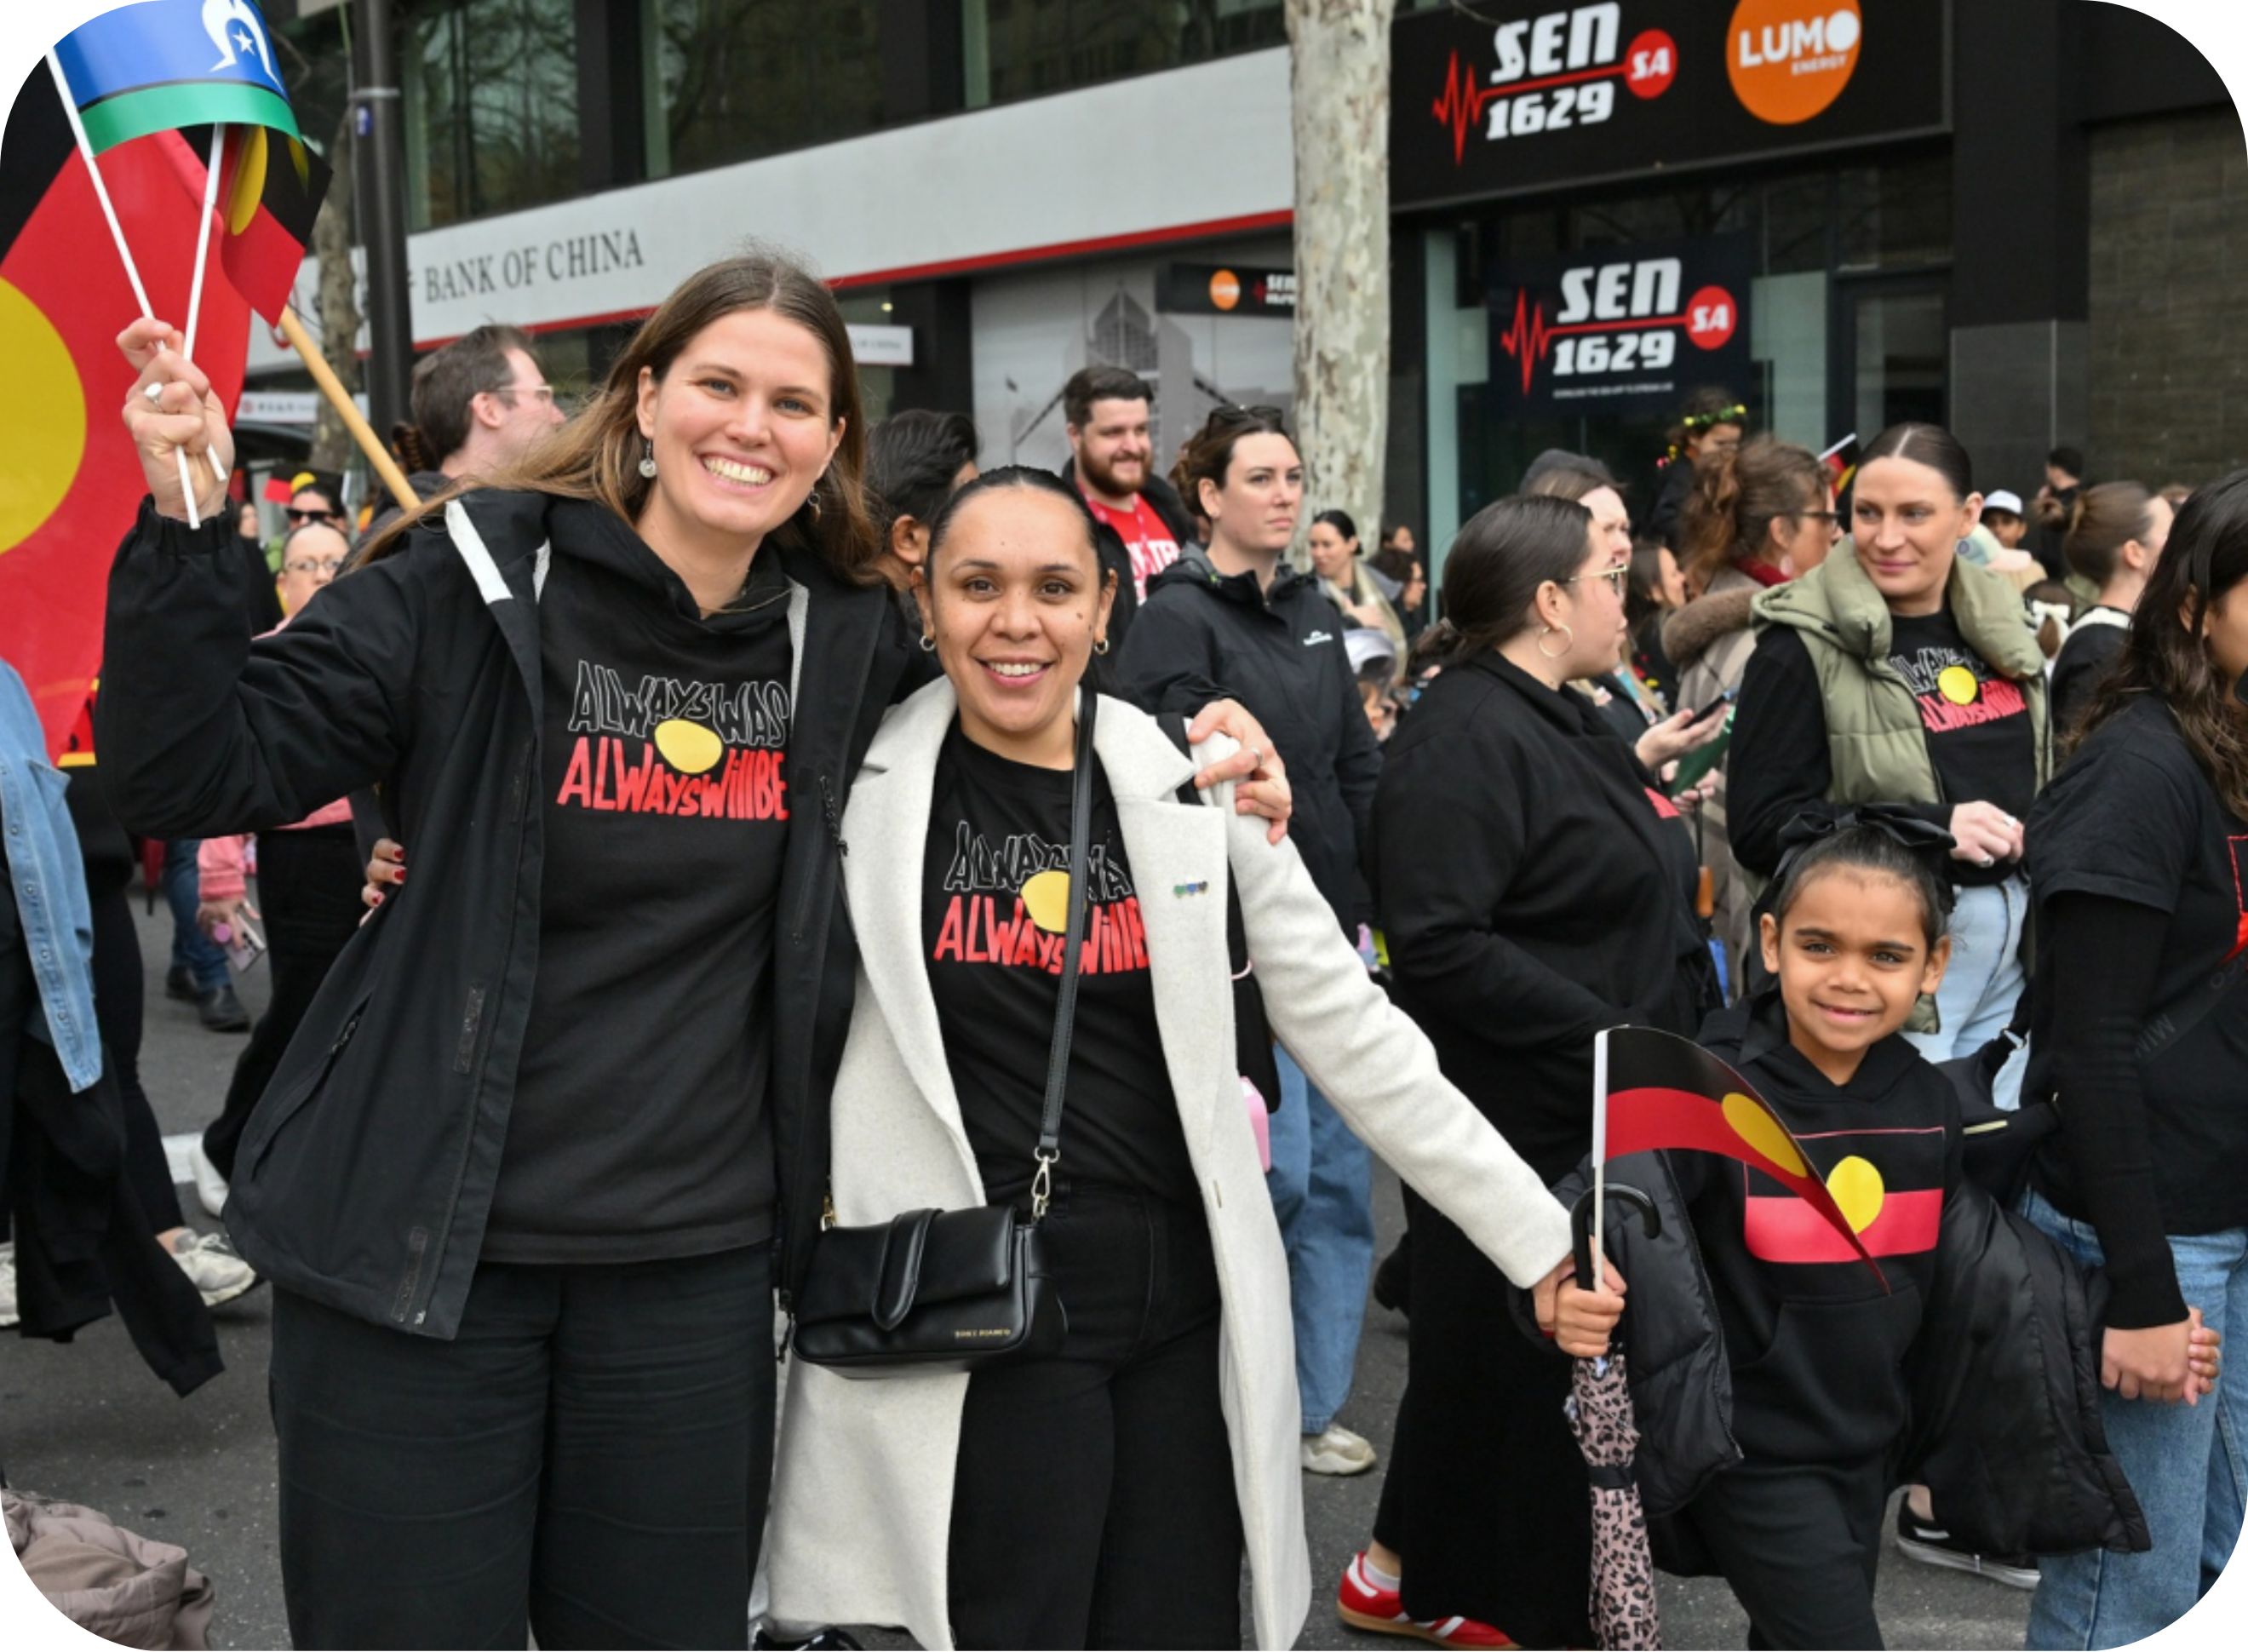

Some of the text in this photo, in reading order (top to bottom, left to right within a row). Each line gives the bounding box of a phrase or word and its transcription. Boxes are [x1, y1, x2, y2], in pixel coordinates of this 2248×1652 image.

[1630, 47, 1672, 81] SA
[1486, 80, 1614, 141] 1629
[425, 227, 645, 304] BANK OF CHINA
[1691, 304, 1729, 333] SA
[1552, 330, 1676, 376] 1629
